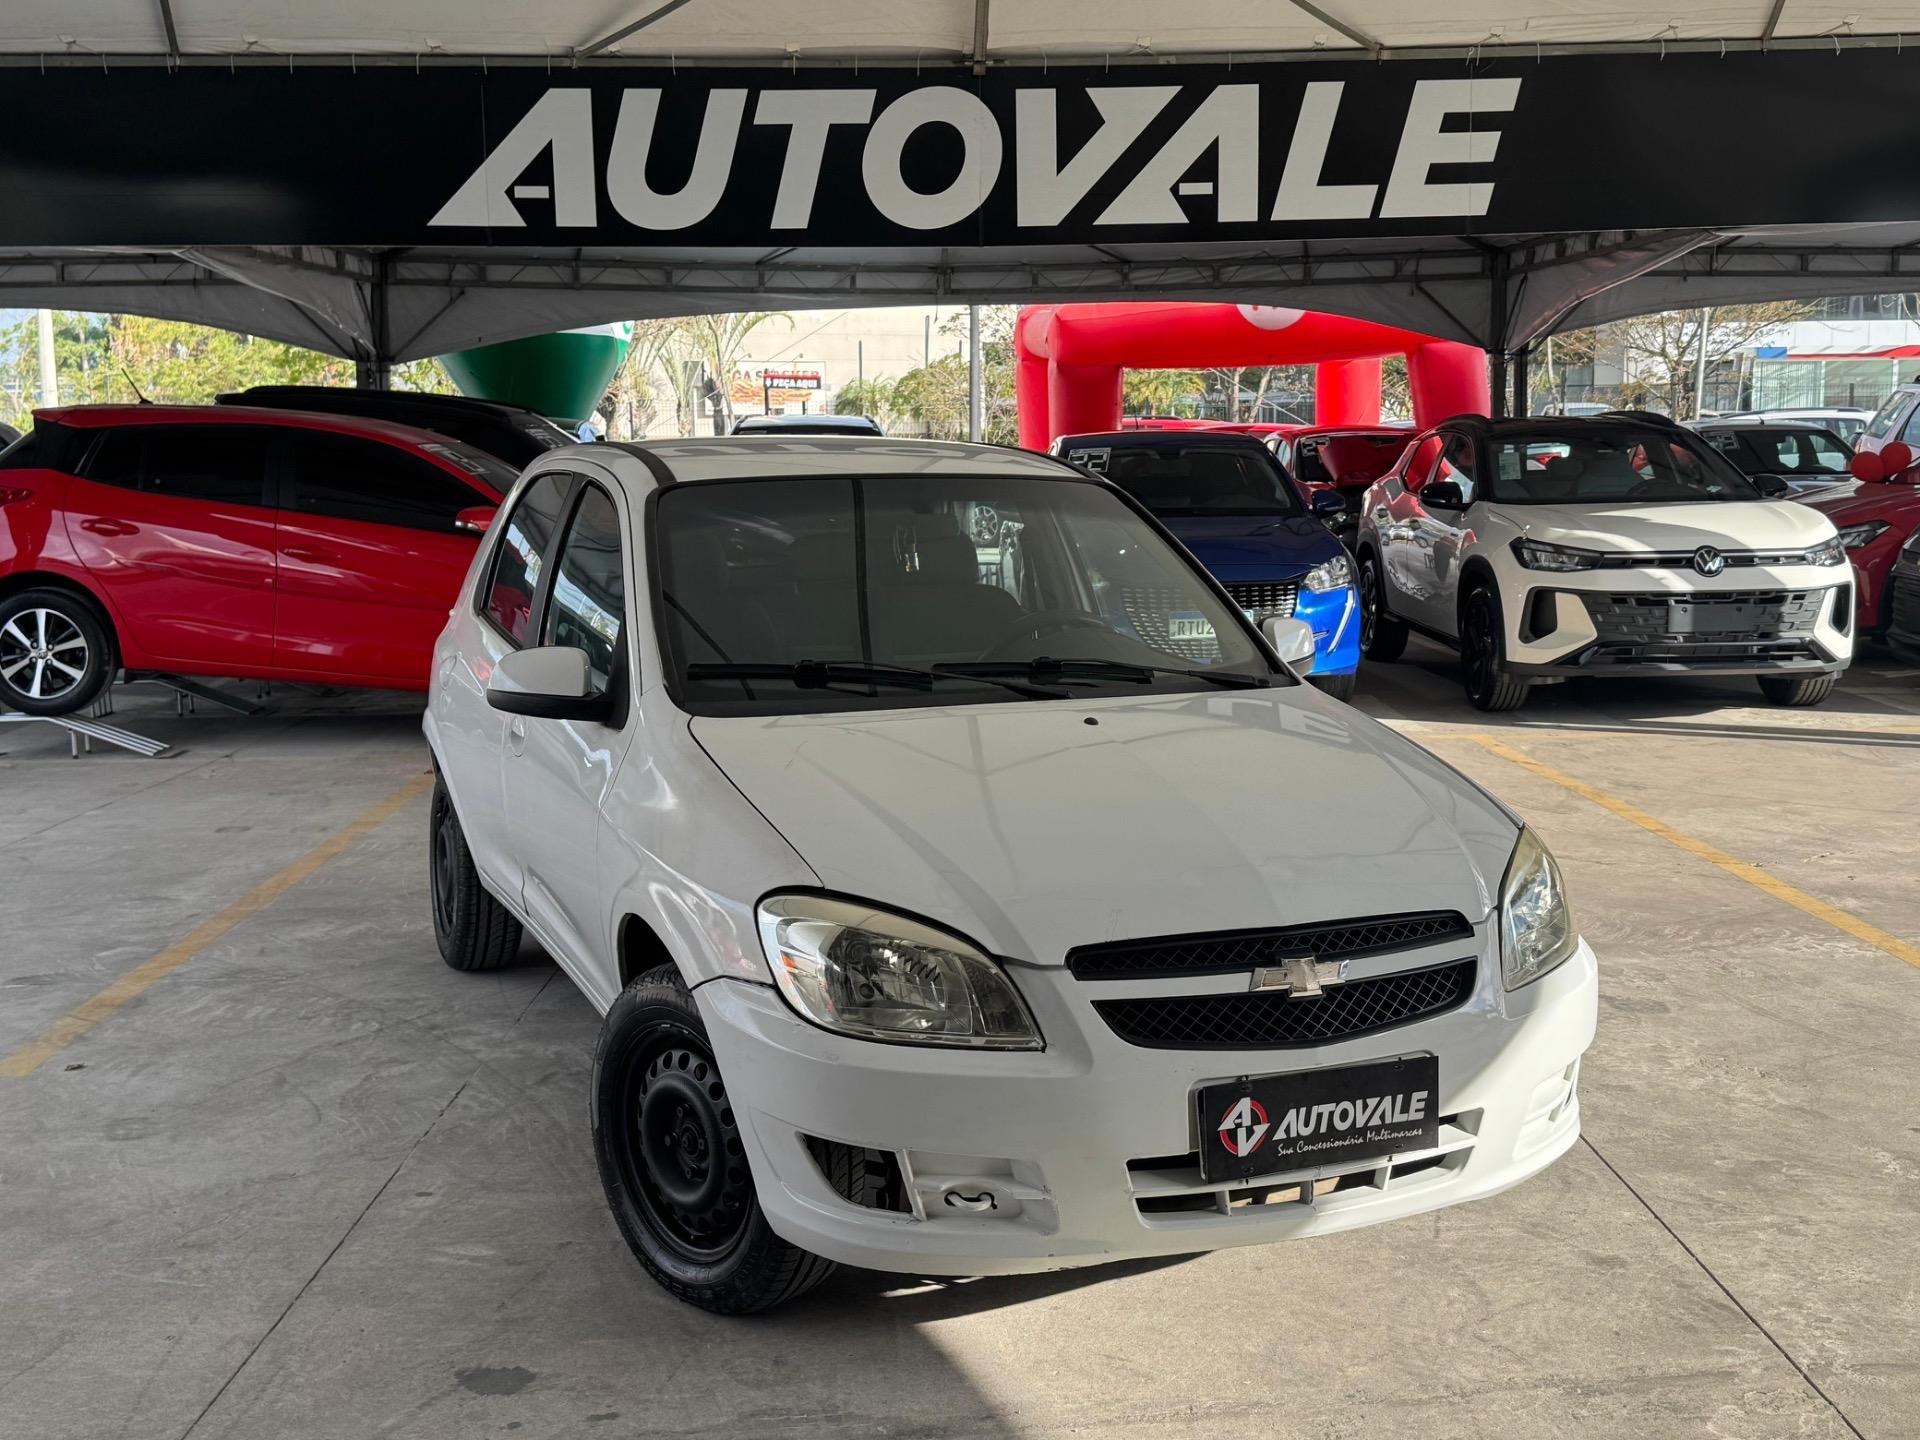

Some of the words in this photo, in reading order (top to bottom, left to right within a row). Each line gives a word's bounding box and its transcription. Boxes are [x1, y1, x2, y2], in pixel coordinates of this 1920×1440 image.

[426, 78, 1522, 230] AUTOVALE
[773, 379, 796, 389] PEÇA
[796, 379, 818, 389] AQUI
[1272, 1090, 1428, 1141] AUTOVALE
[1277, 1143, 1294, 1157] Sua
[1297, 1135, 1364, 1152] Concessionária
[1367, 1128, 1423, 1144] Multimarcas
